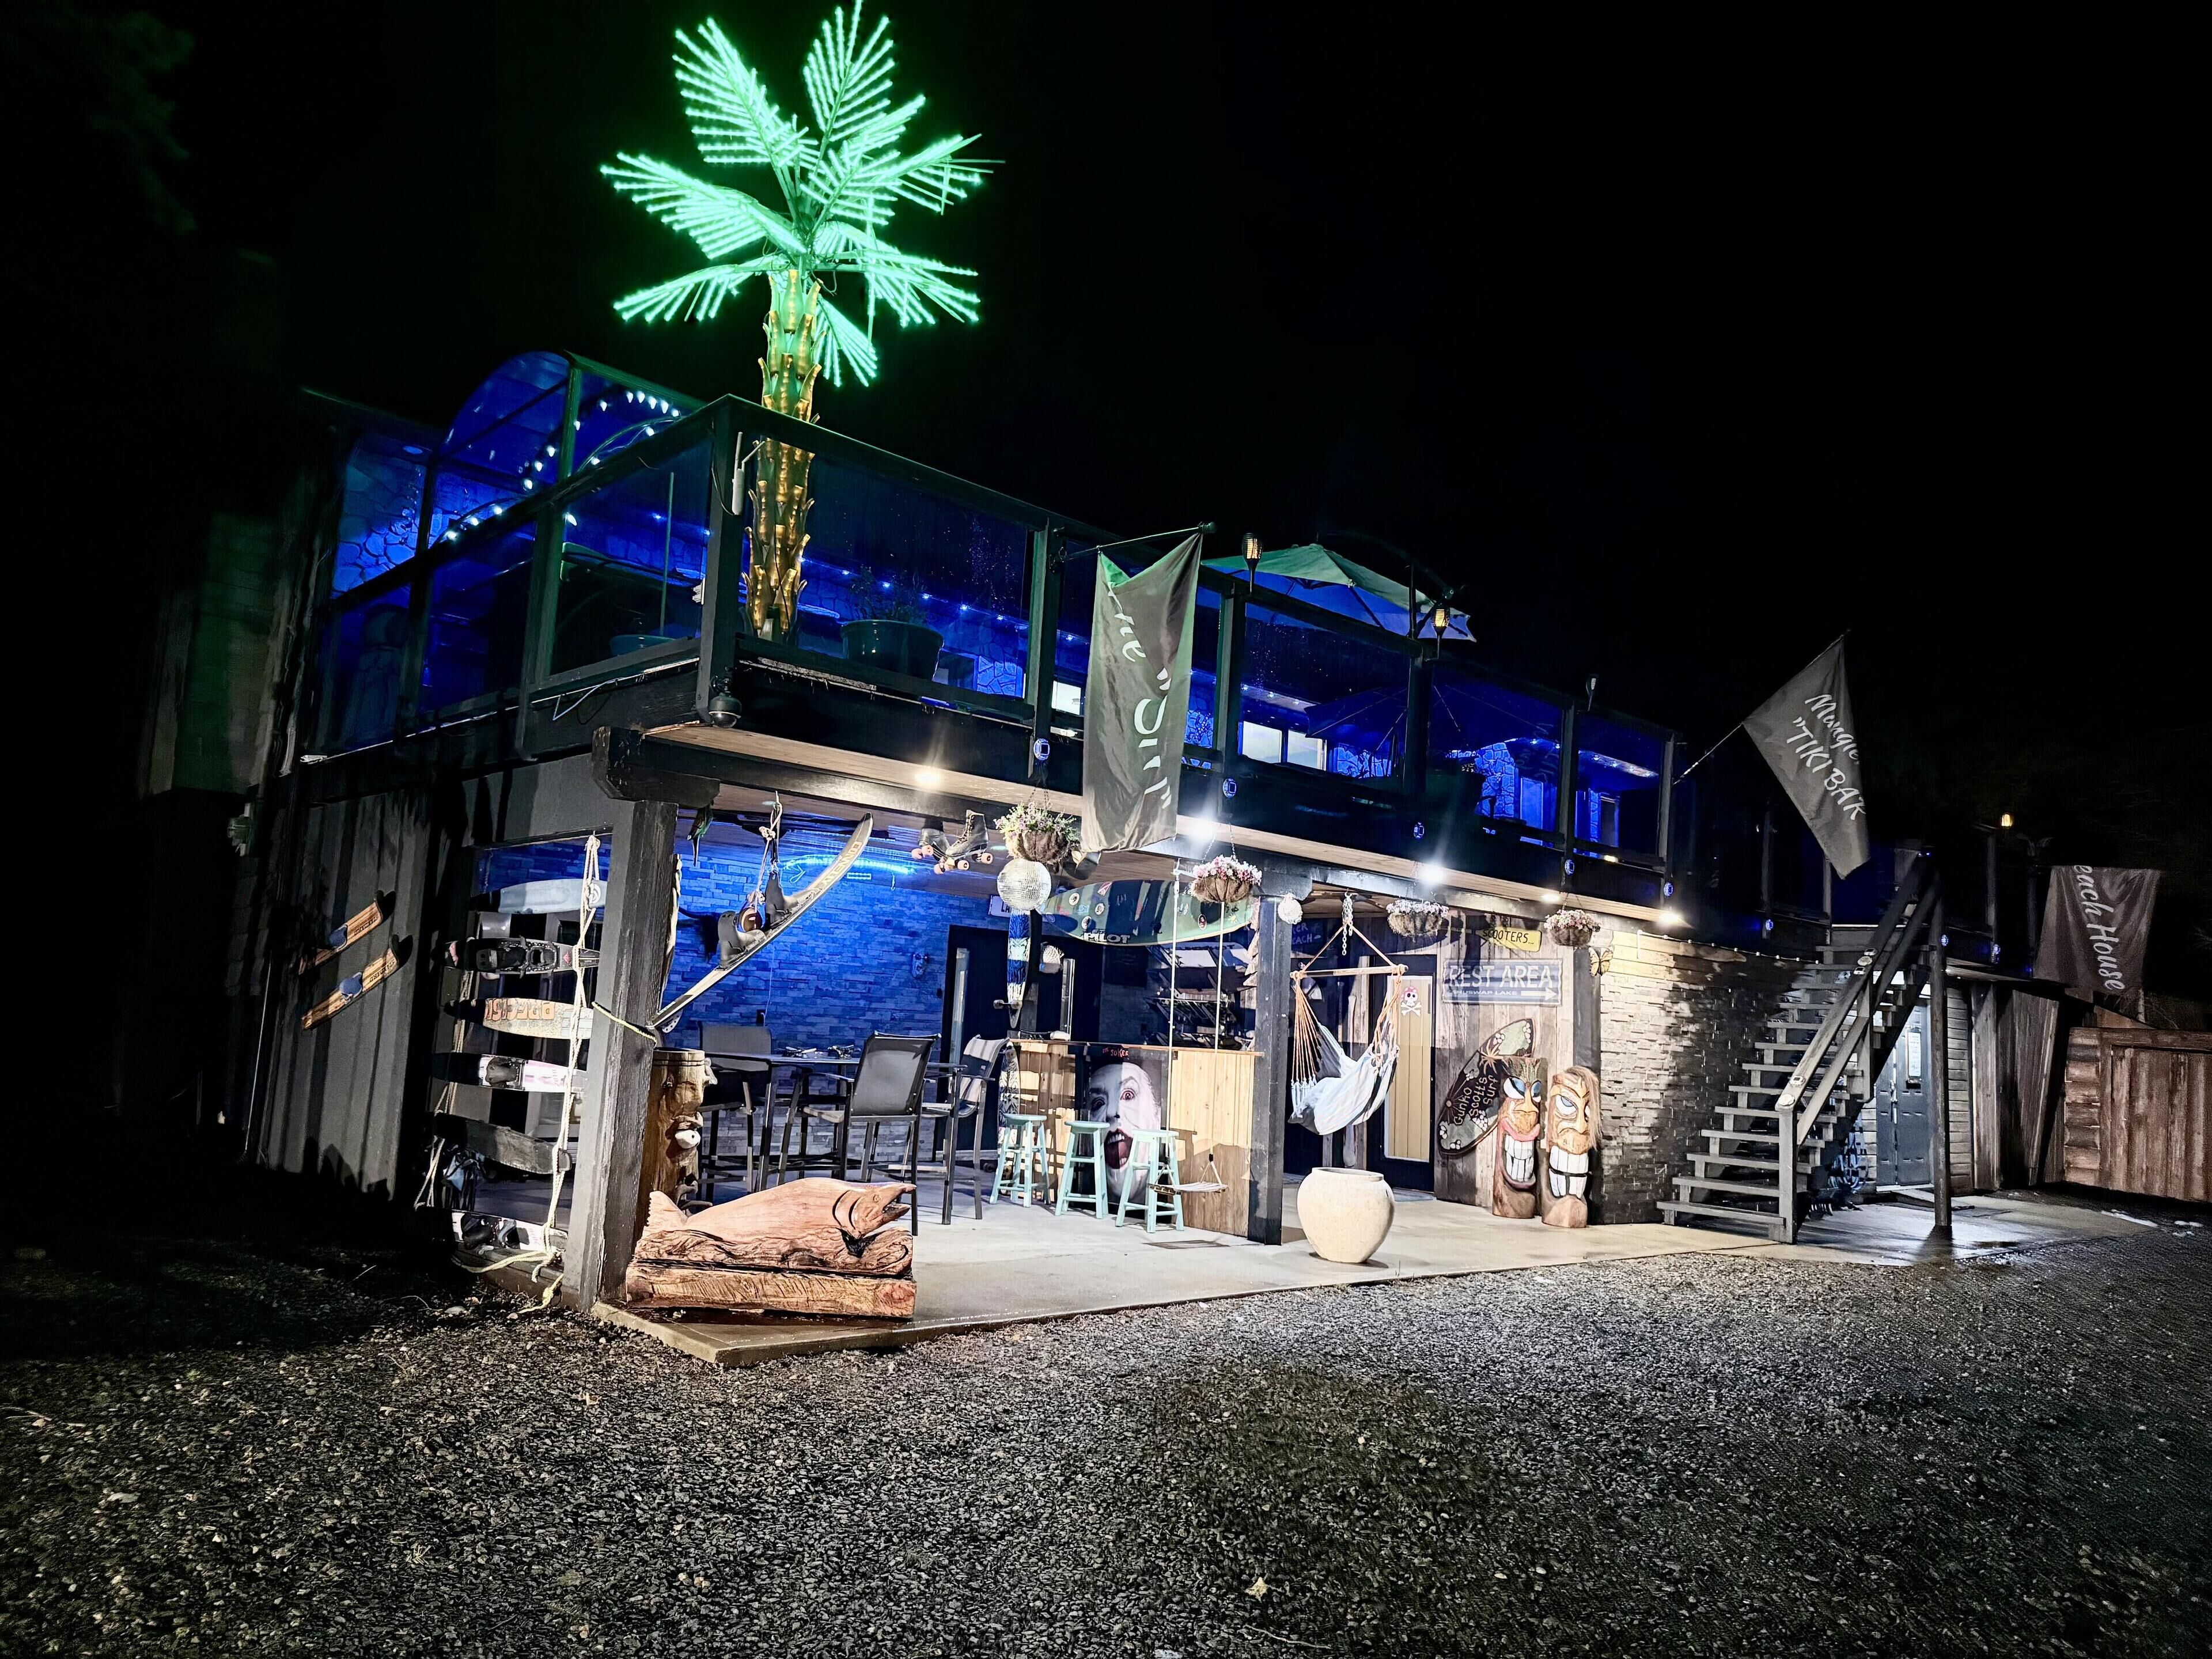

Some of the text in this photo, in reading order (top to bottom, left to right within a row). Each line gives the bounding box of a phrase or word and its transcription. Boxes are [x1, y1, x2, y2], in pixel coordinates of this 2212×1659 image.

[2074, 865, 2126, 991] each House
[1449, 965, 1554, 988] REST AREA
[1483, 1074, 1499, 1105] Surf
